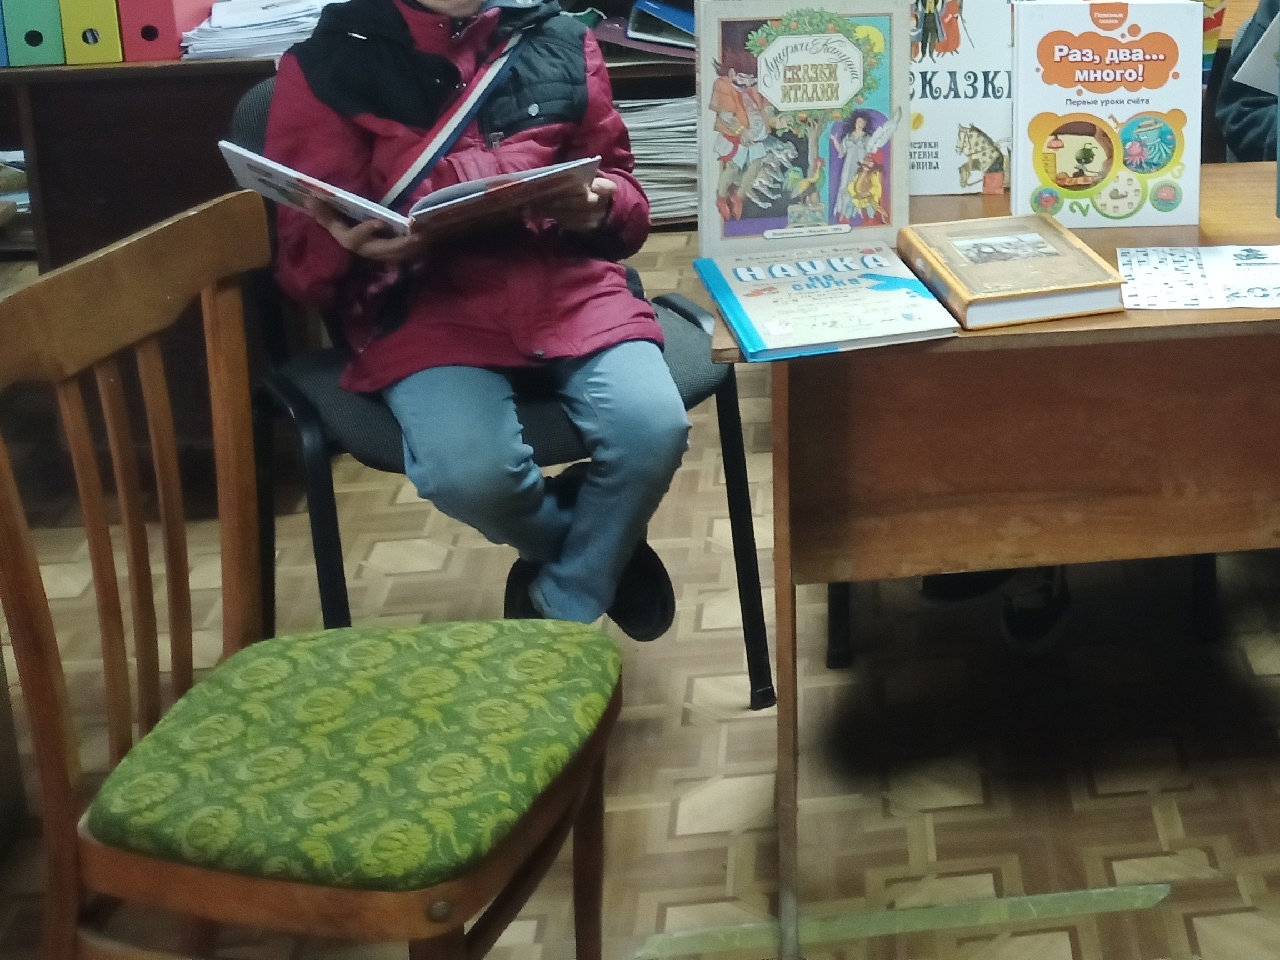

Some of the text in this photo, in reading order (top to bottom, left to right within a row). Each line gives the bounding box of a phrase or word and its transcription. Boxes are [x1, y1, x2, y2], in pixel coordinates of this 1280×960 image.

[1053, 44, 1166, 65] Раз, два...
[783, 63, 839, 84] СКАЗКИ
[1074, 63, 1145, 83] много!
[1065, 97, 1150, 108] Первые уроки счёта
[733, 253, 892, 282] НАУКА
